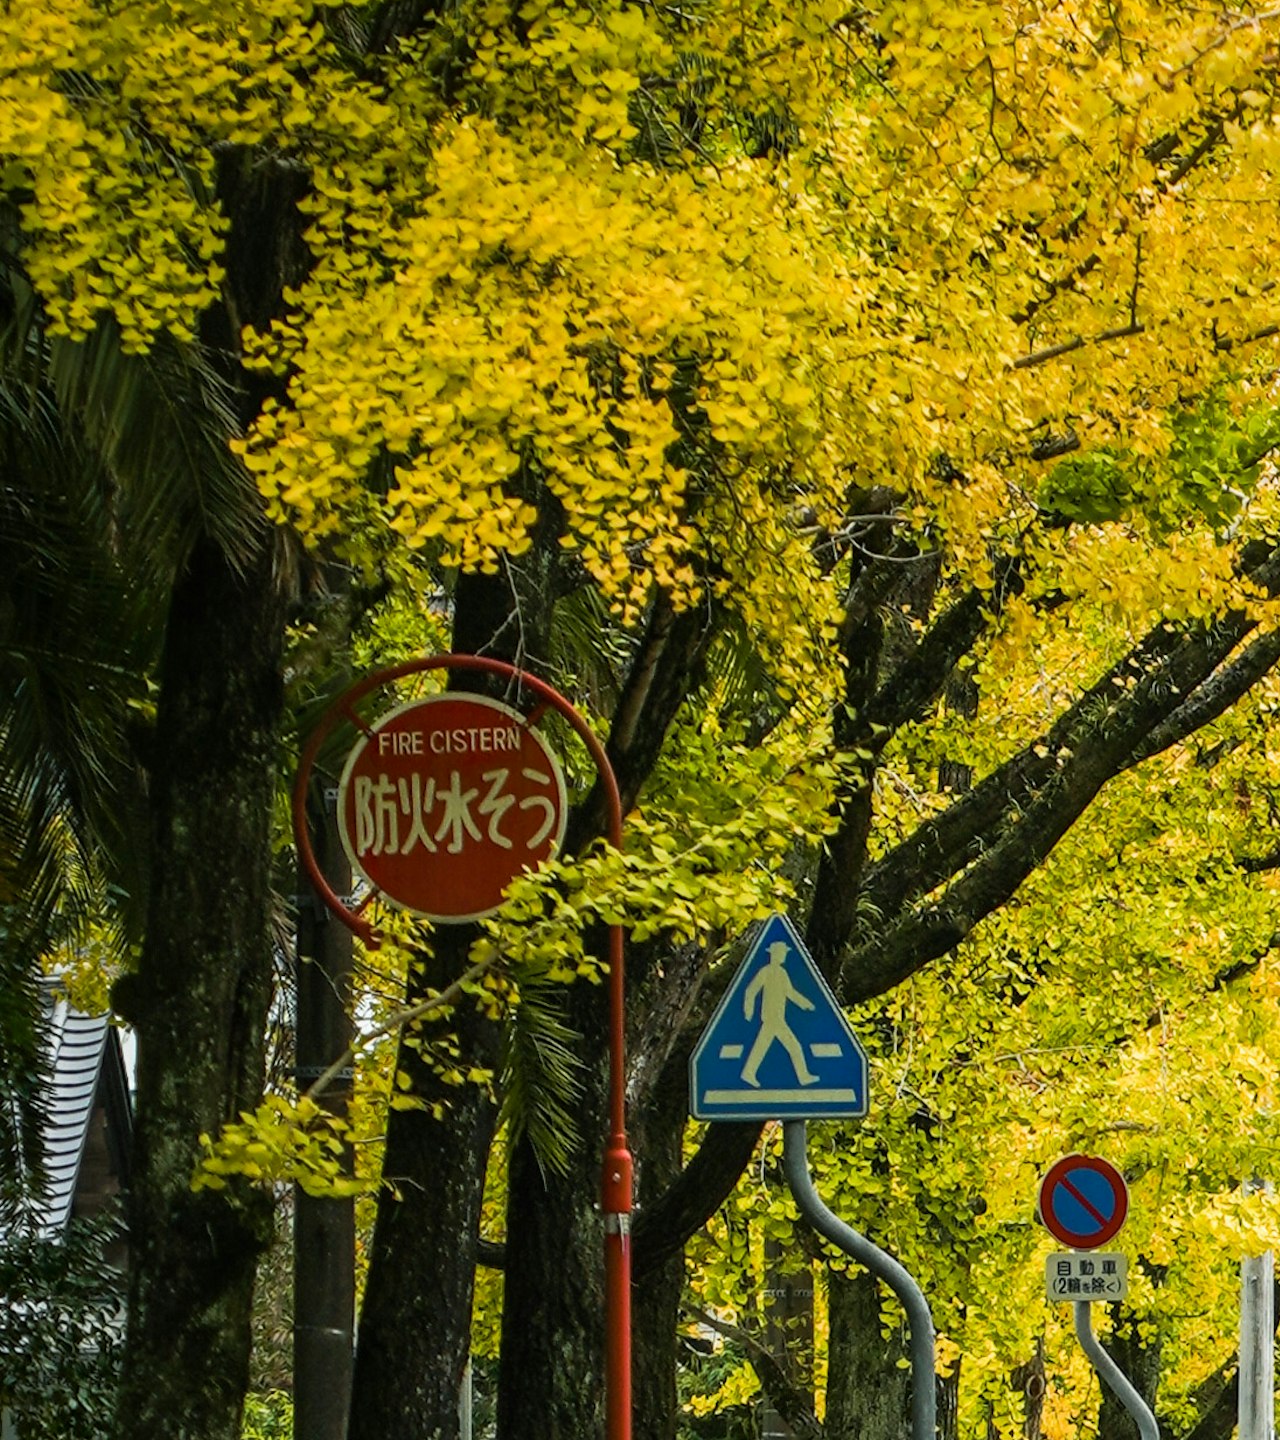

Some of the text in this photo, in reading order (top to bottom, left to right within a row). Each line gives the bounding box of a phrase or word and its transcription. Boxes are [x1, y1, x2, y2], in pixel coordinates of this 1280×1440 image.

[378, 727, 521, 757] FIRE CISTERN
[354, 767, 556, 857] 防火水そう
[1057, 1260, 1117, 1276] 自動車
